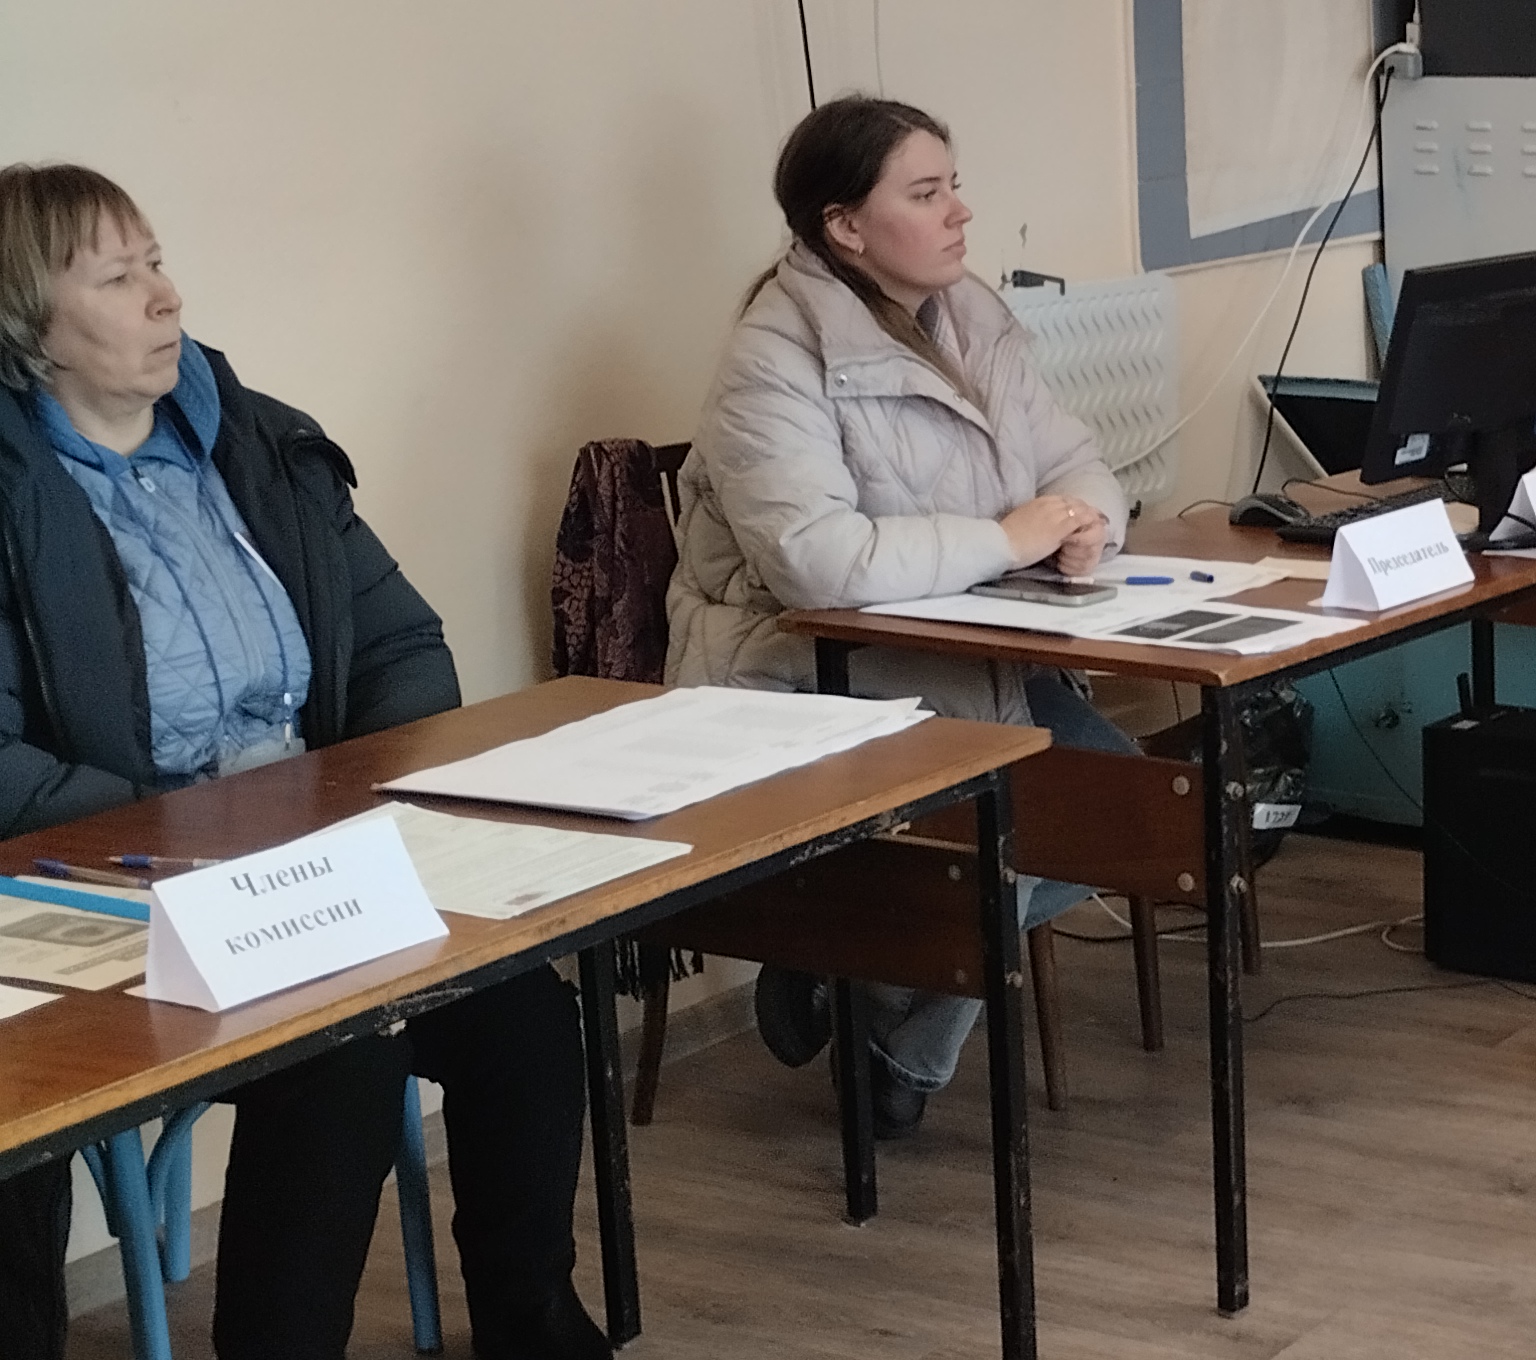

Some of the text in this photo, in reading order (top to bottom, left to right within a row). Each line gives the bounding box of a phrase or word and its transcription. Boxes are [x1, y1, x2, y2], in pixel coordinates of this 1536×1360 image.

[1367, 540, 1450, 577] Председатель
[230, 856, 334, 897] Члены
[225, 898, 364, 956] комиссии
